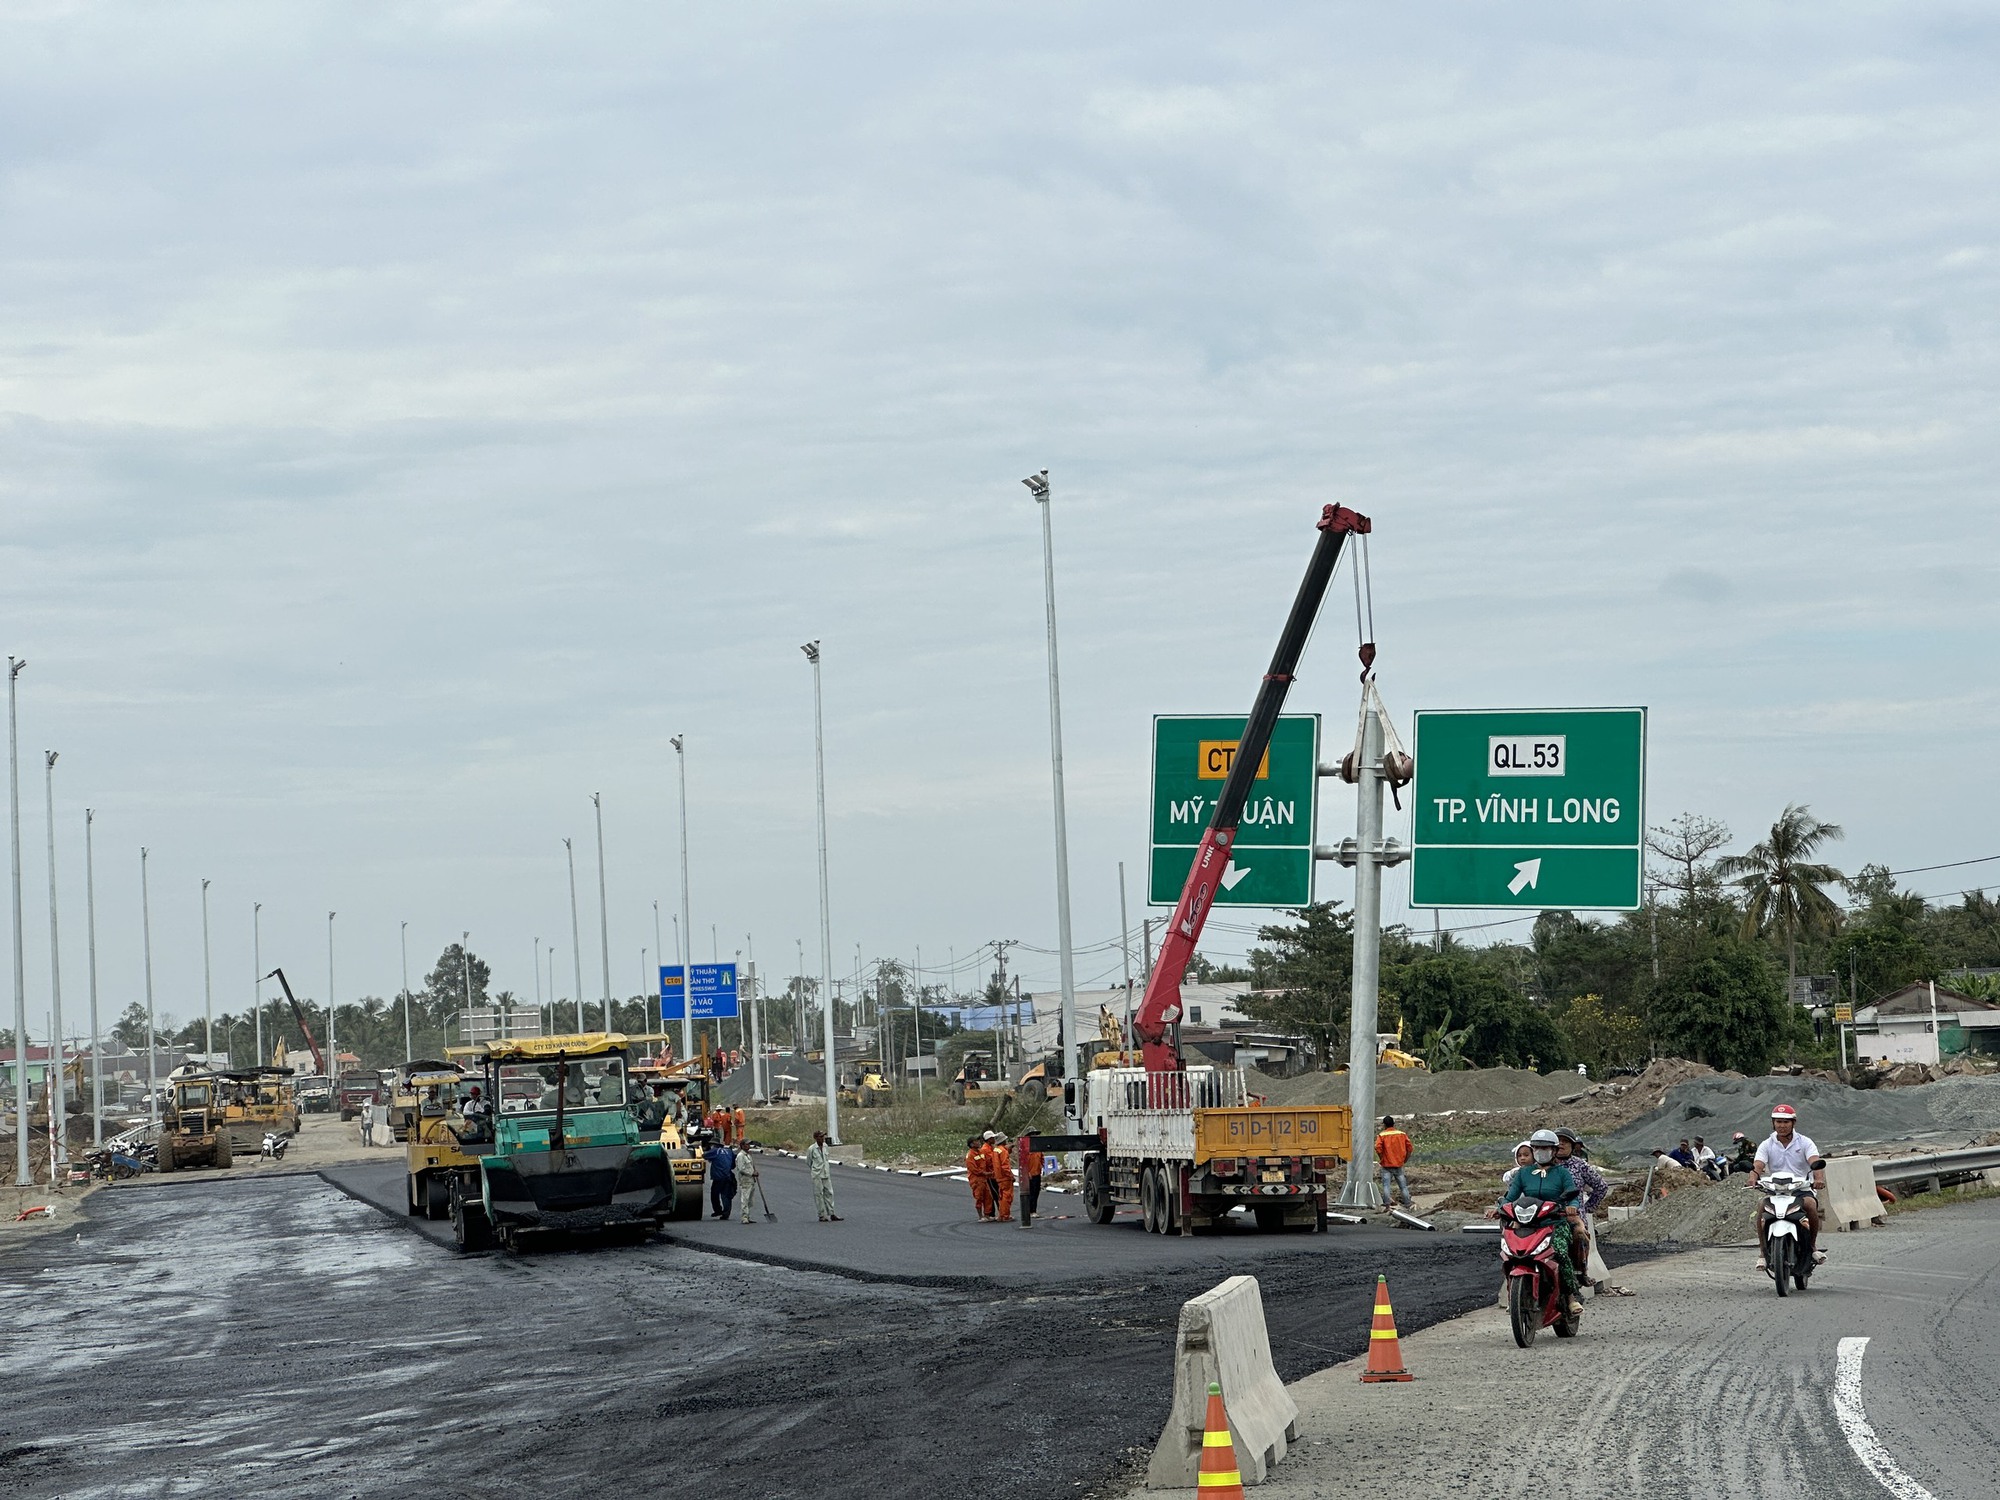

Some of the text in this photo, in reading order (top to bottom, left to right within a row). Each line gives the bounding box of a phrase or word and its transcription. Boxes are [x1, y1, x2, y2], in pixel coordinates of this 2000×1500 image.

[1494, 743, 1560, 769] QL.53
[1170, 795, 1295, 829] MỸ UẬN
[1433, 793, 1620, 823] TP. VĨNH LONG
[697, 997, 713, 1006] VÀO
[1230, 1121, 1246, 1136] 51
[1299, 1119, 1317, 1134] 50
